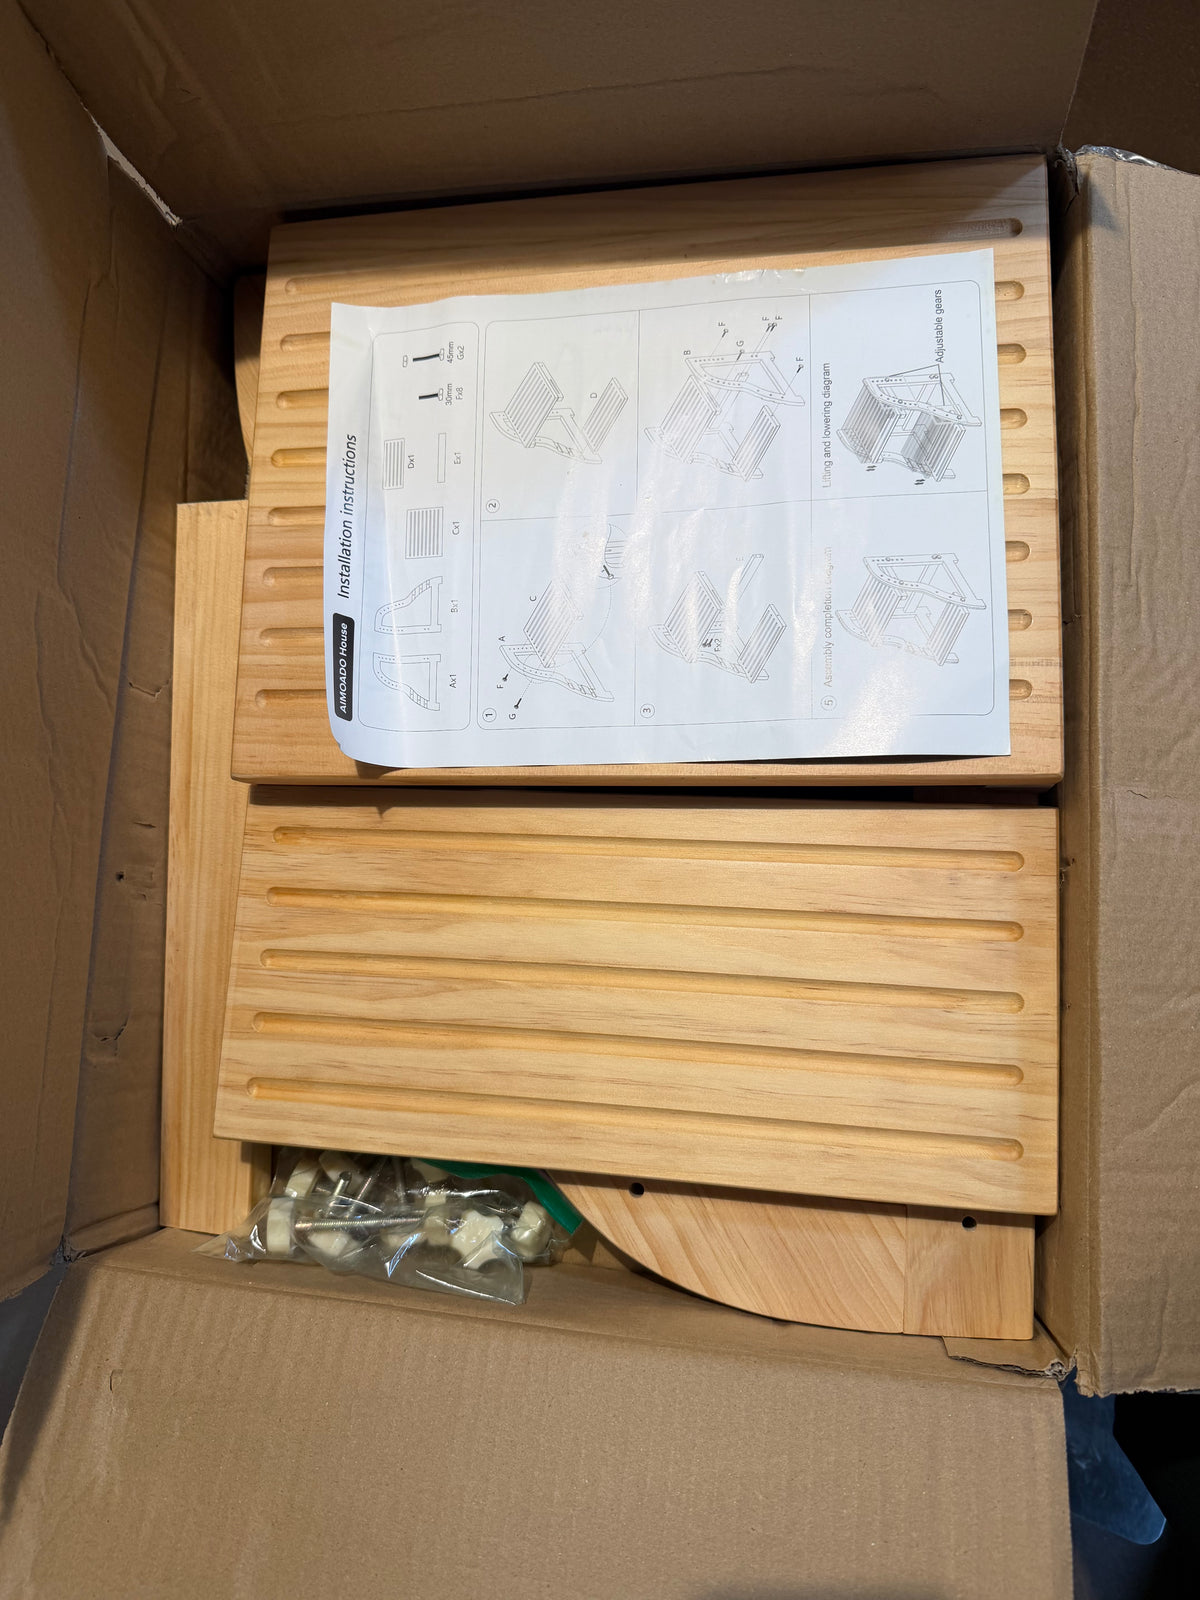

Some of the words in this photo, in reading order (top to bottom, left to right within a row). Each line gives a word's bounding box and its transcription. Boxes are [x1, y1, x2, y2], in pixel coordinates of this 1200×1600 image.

[934, 289, 945, 315] gears
[457, 345, 465, 361] Gx2
[934, 317, 946, 364] Adjustable
[456, 387, 464, 400] Fx8
[822, 363, 832, 399] diagram
[445, 383, 453, 406] 30mm
[822, 401, 832, 439] lowering
[407, 454, 415, 469] Dx1
[822, 441, 831, 459] and
[339, 434, 357, 516] instructions
[822, 461, 833, 488] Lifting
[452, 521, 460, 536] Cx1
[337, 520, 352, 599] Installation
[450, 599, 458, 613] Bx1
[340, 622, 348, 656] House
[339, 659, 347, 714] AIMOADO
